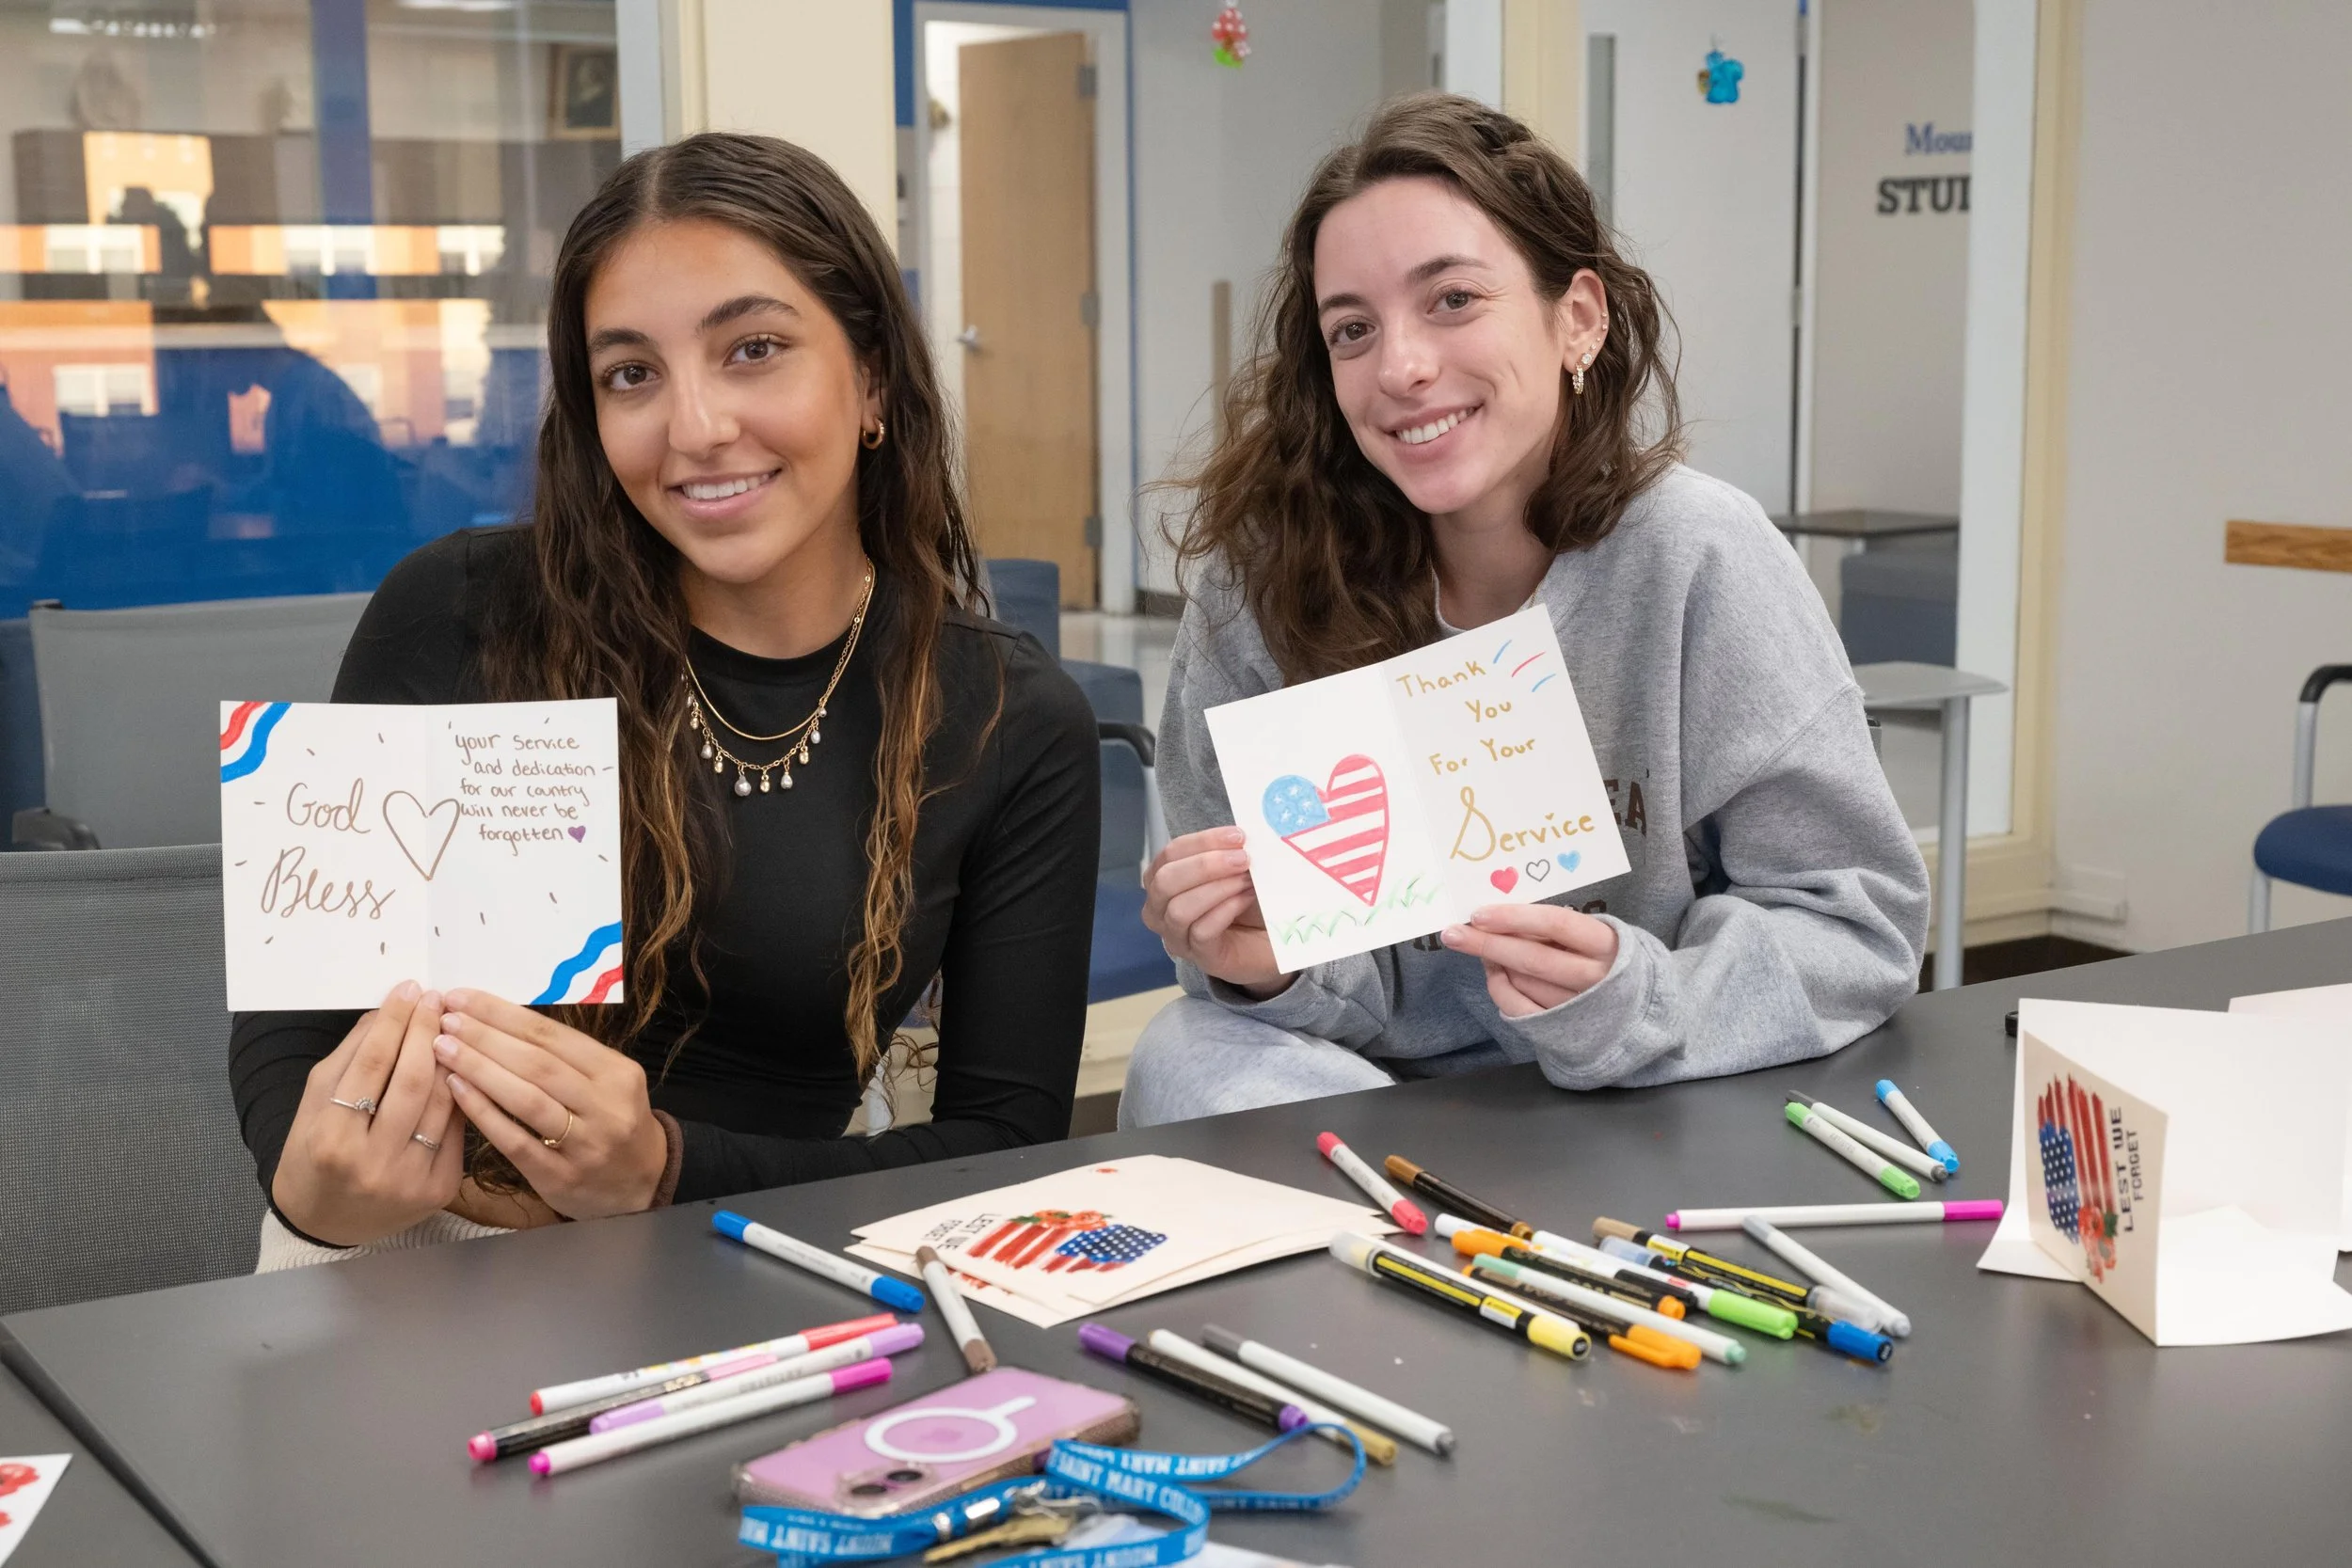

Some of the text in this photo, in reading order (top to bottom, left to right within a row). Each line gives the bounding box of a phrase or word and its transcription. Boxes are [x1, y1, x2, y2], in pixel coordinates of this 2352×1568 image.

[1395, 660, 1486, 698] Thank
[1464, 699, 1513, 723] You
[474, 758, 596, 777] and dedication
[1428, 737, 1535, 776] For Your
[287, 777, 372, 834] God
[460, 777, 591, 807] for our country
[501, 804, 548, 818] never
[553, 802, 580, 820] be
[479, 823, 564, 857] forgotten
[1450, 786, 1596, 863] Service
[261, 847, 396, 920] Bless
[2109, 1107, 2135, 1234] LEST WE
[2126, 1129, 2145, 1201] FORGET
